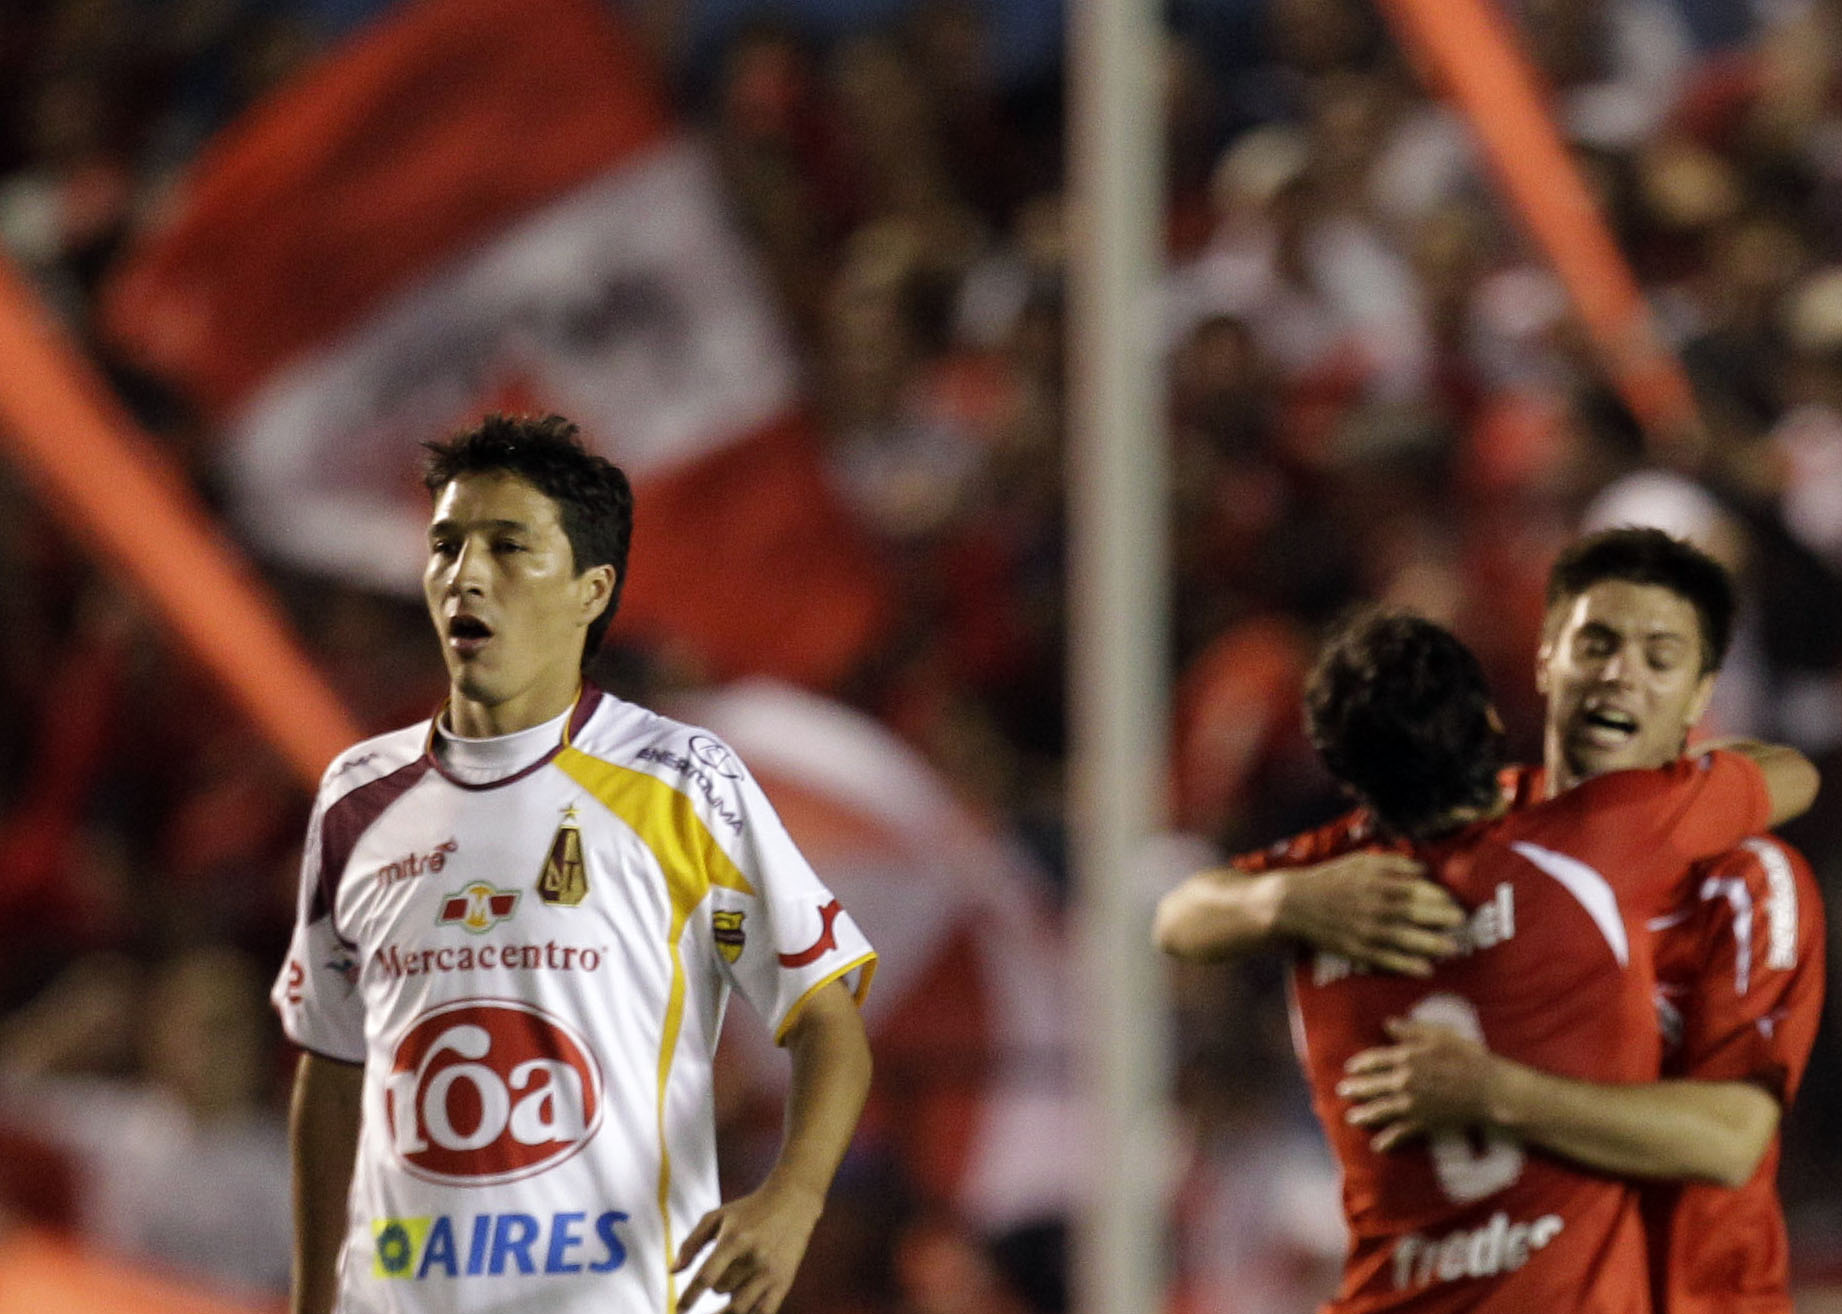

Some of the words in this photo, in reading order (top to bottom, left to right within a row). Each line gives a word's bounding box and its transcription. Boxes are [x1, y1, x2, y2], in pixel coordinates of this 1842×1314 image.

[376, 842, 453, 886] mitre
[377, 940, 601, 978] Mercacentro
[415, 1211, 630, 1281] AIRES
